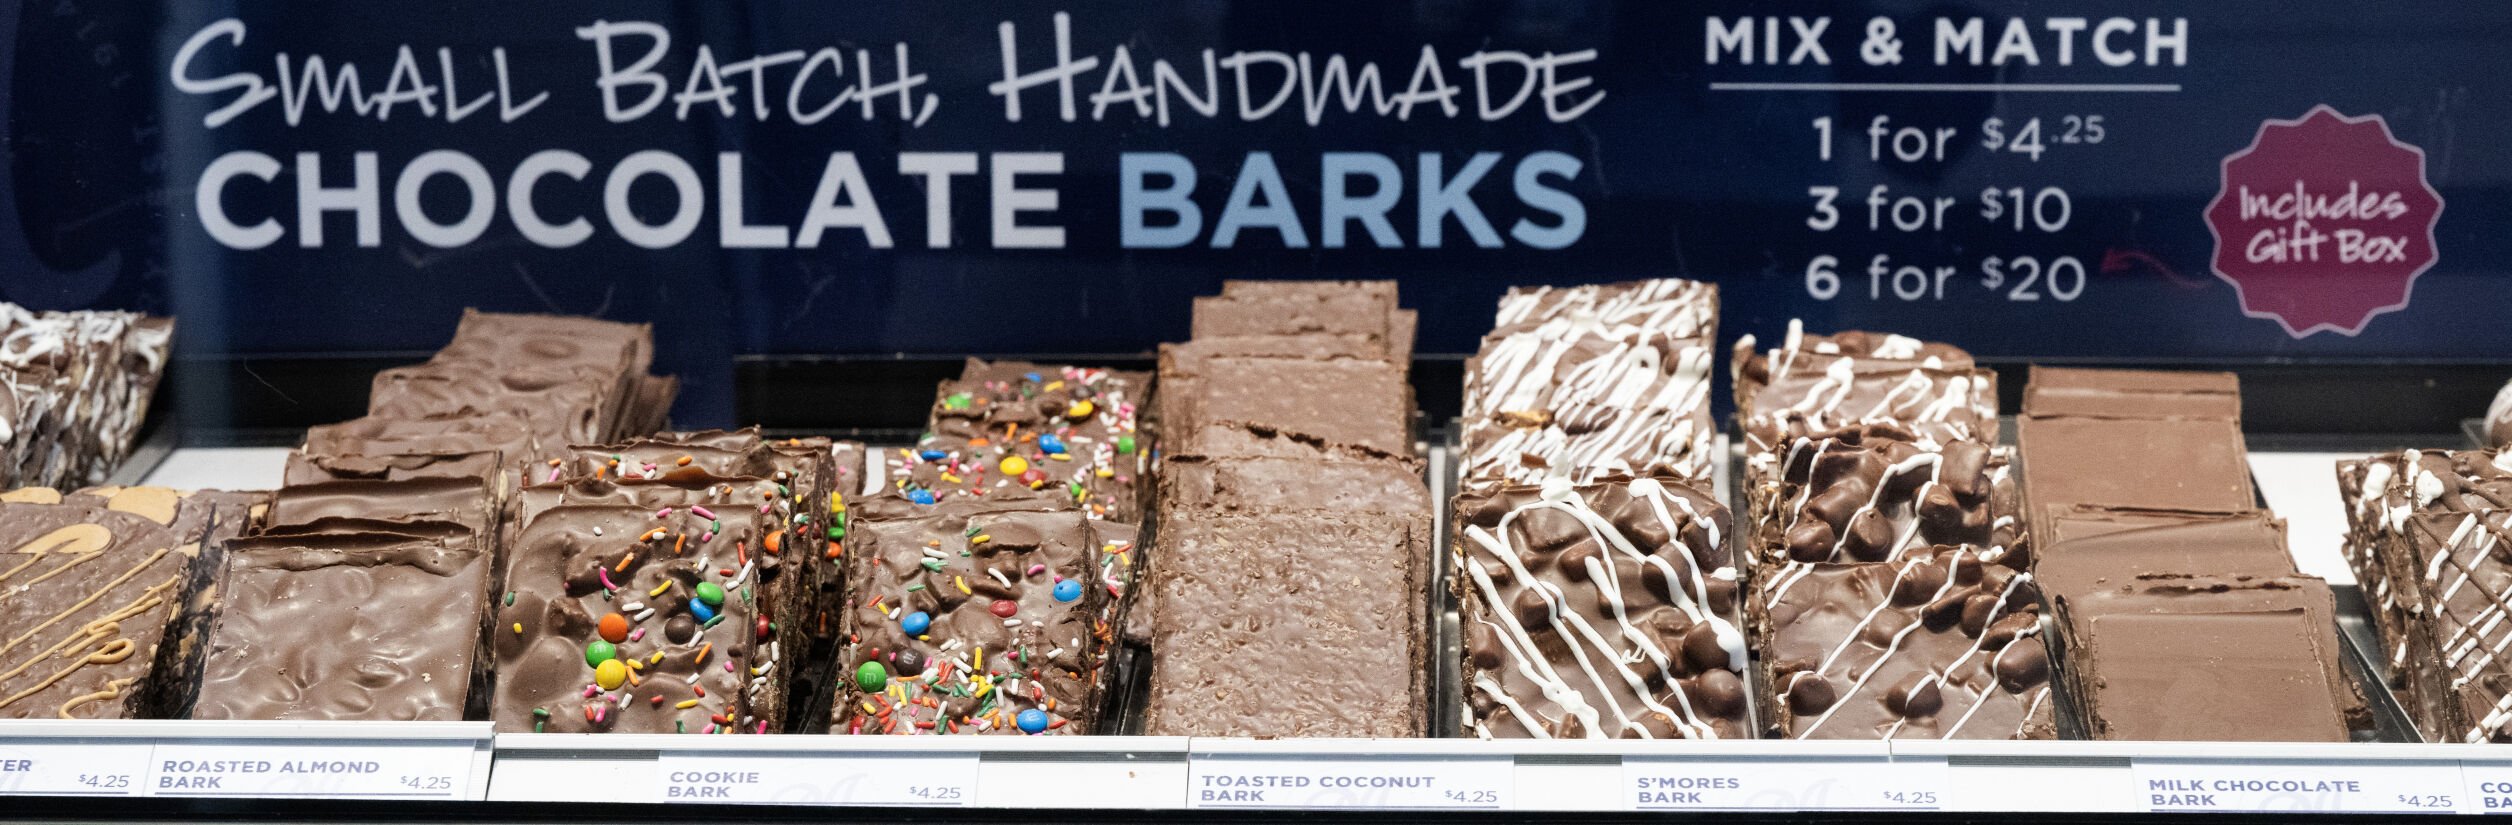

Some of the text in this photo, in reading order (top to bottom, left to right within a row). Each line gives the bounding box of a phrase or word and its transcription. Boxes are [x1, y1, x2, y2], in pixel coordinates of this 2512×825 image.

[1705, 16, 2188, 67] MIX & MATCH
[1813, 115, 2105, 162] 1 for $4.25
[195, 149, 1587, 250] CHOCOLATE BARKS
[2239, 180, 2408, 221] Includes
[1807, 184, 2071, 233] 3 for $10
[2245, 220, 2408, 264] Gift Box
[1805, 254, 2086, 302] 6 for $20
[0, 759, 33, 772] ER
[162, 760, 380, 774] ROASTED ALMOND
[78, 773, 130, 788] $4.25
[159, 775, 222, 789] BARK
[400, 775, 452, 790] $4.25
[670, 771, 760, 784] COOKIE
[1201, 775, 1436, 788] TOASTED COCONUT
[1637, 777, 1740, 789] S'MORES
[667, 785, 731, 798] BARK
[909, 785, 961, 800] $4.25
[2148, 779, 2361, 793] MILK CHOCOLATE
[1201, 789, 1265, 802] BARK
[1444, 789, 1498, 803] $4.25
[1638, 791, 1702, 804] BARK
[1883, 790, 1937, 804] $4.25
[2151, 794, 2217, 806] BARK
[2398, 794, 2453, 808] $4.25
